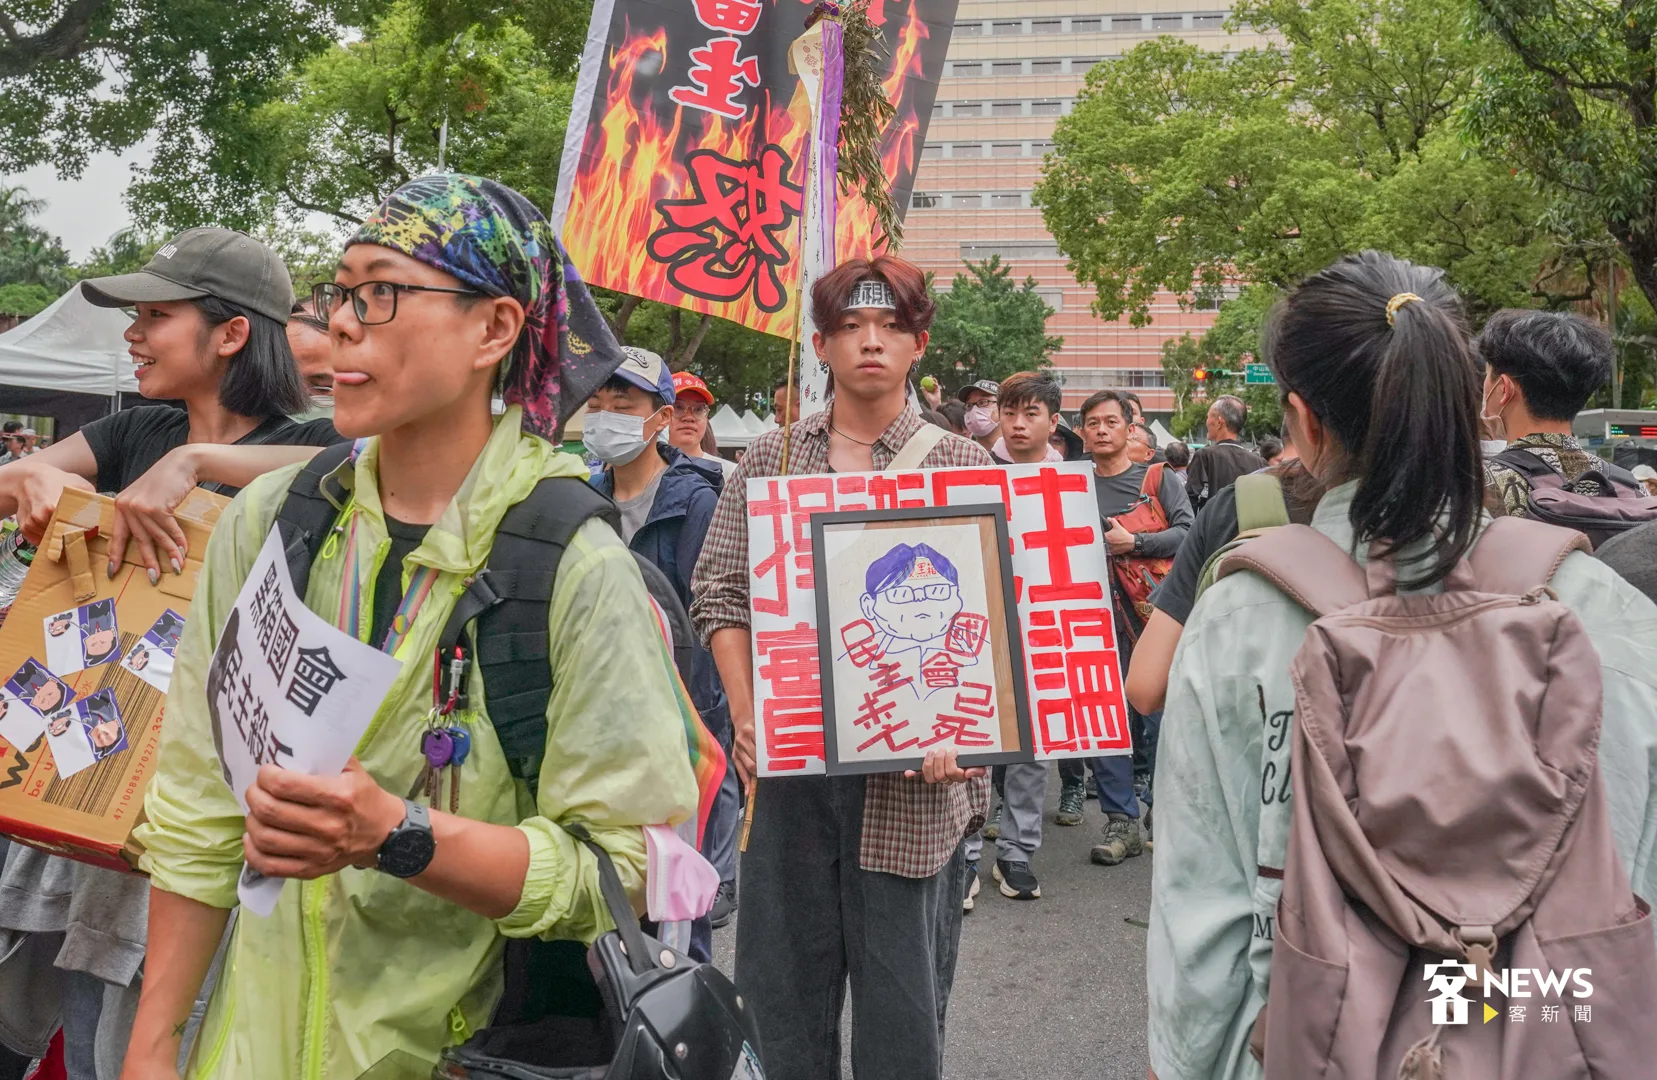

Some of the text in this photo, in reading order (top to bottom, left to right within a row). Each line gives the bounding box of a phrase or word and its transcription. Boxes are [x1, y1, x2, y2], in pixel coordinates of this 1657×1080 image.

[249, 559, 348, 717] 黑箱國會
[28, 779, 45, 798] be
[113, 737, 157, 821] 4710088570277
